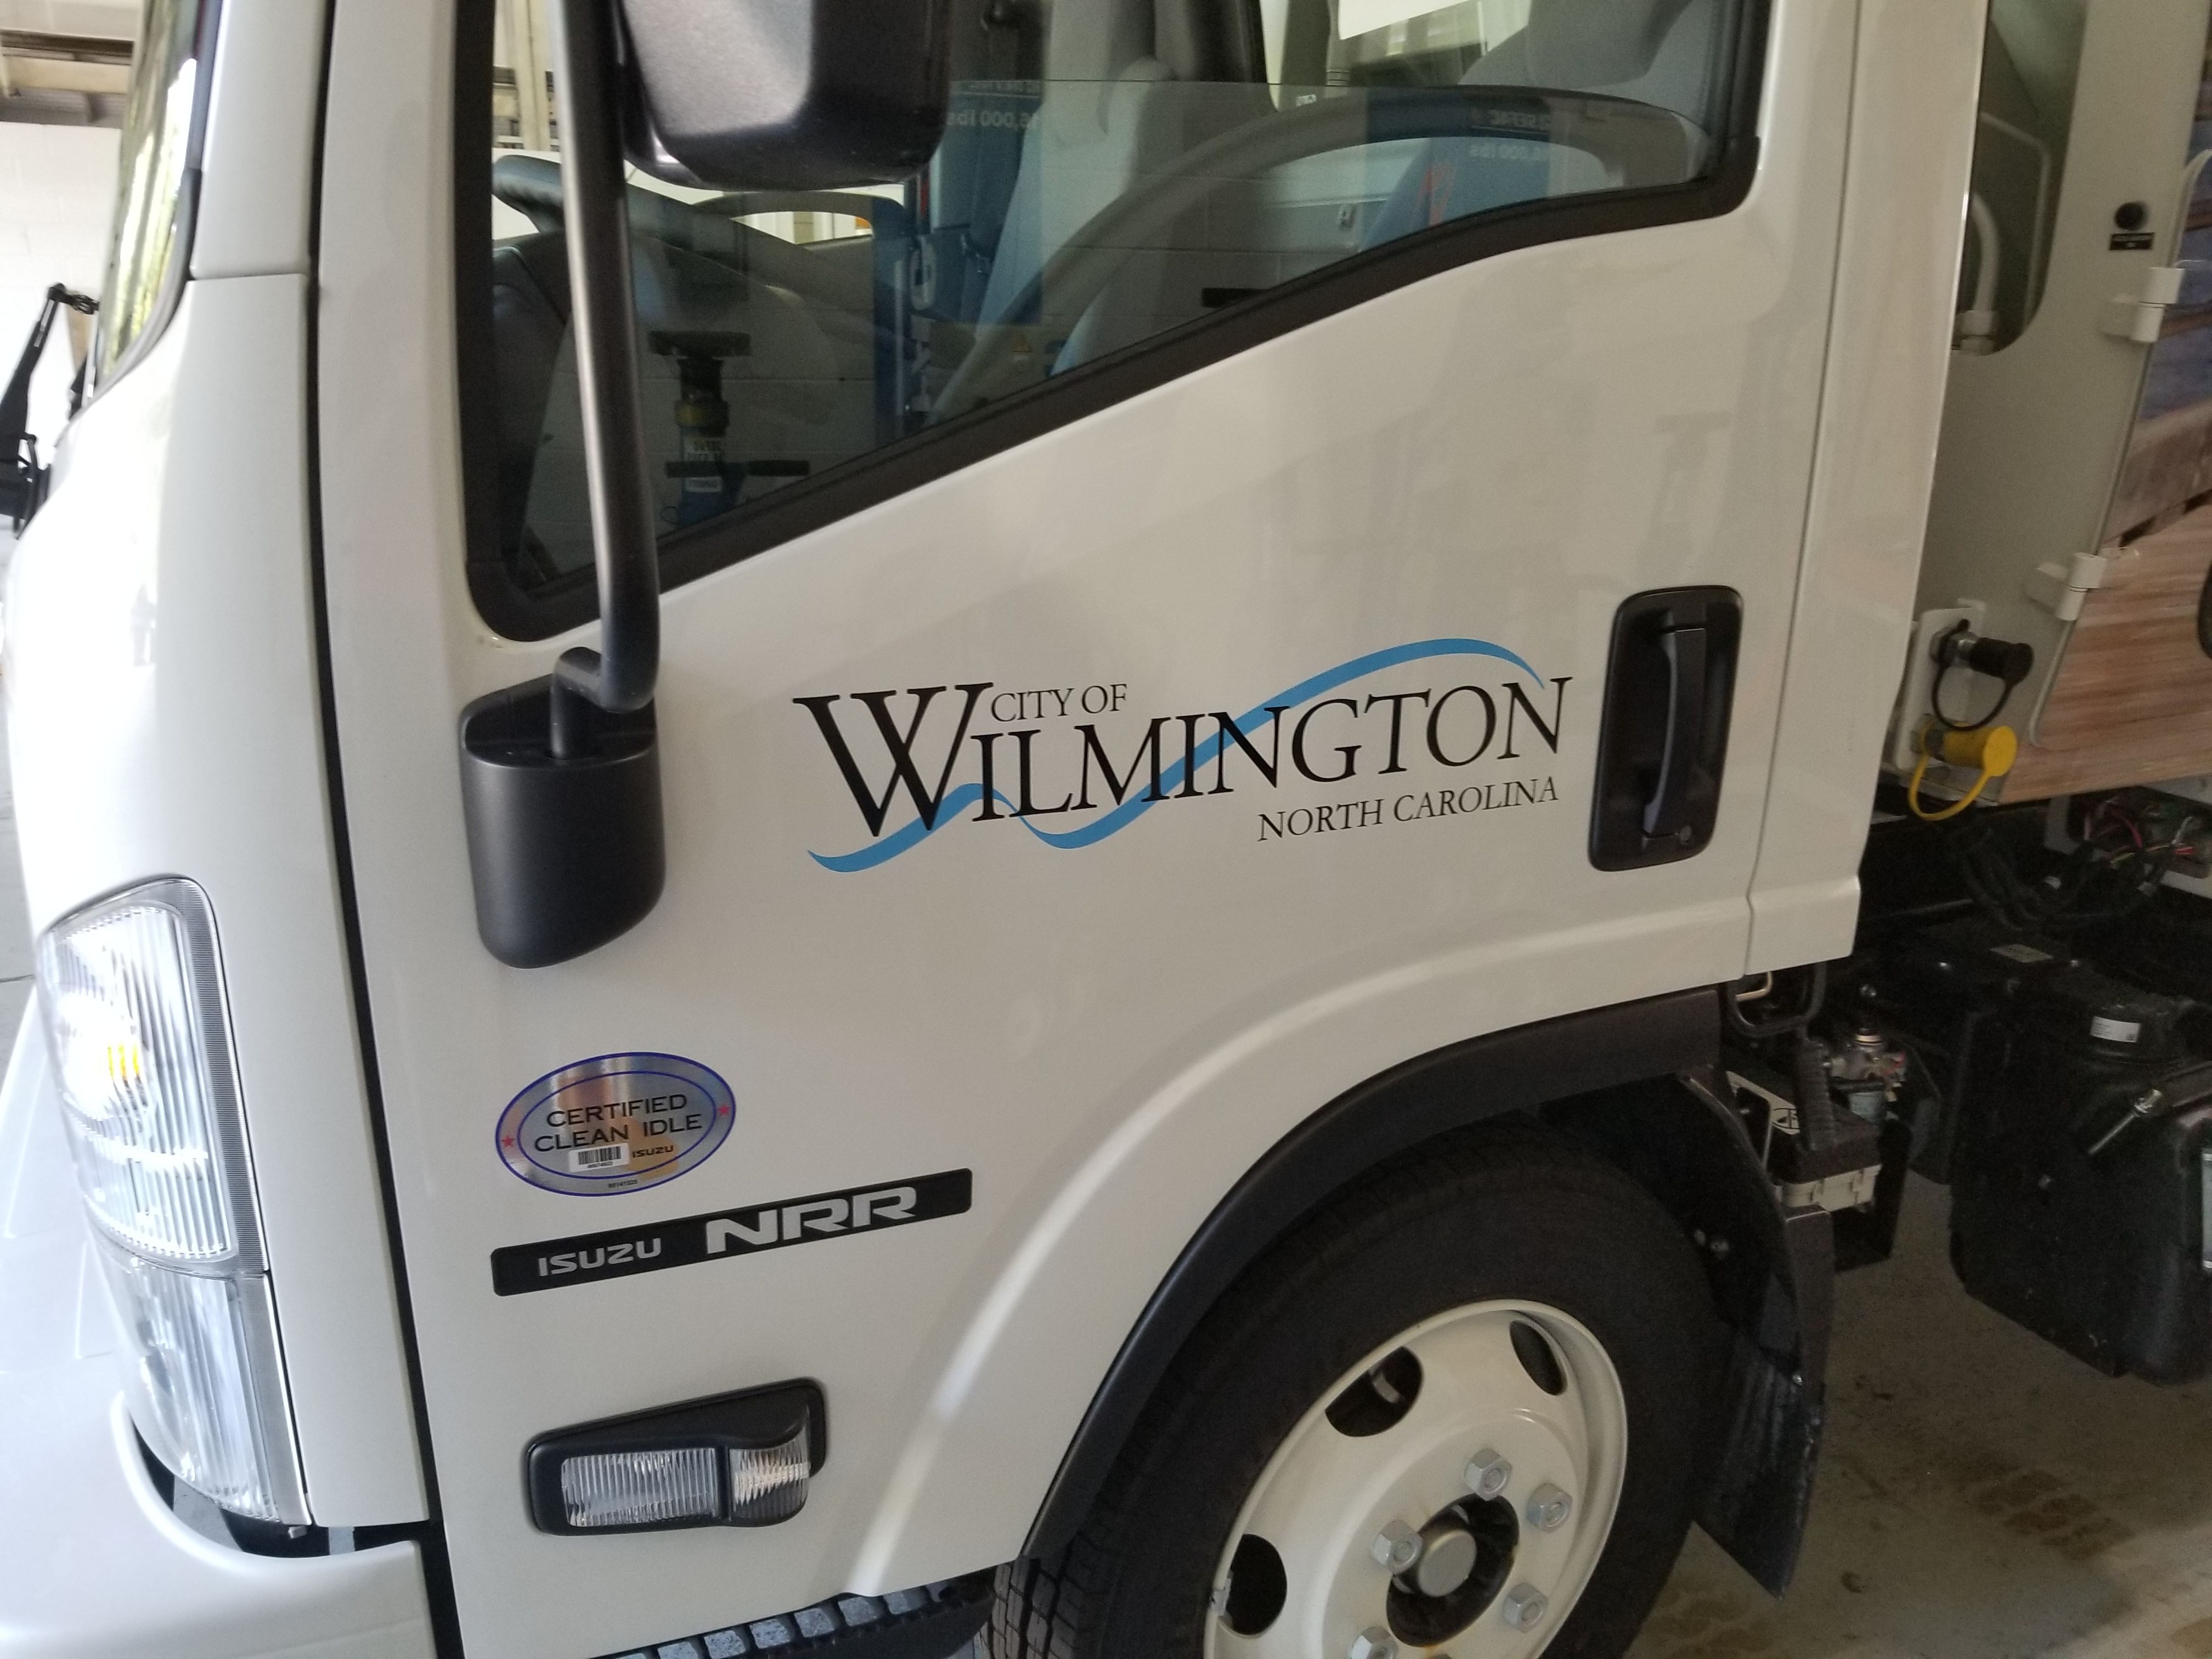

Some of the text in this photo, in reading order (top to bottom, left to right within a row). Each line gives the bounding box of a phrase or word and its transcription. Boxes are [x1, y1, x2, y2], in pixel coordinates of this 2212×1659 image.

[991, 684, 1127, 722] CITY OF
[792, 676, 1573, 837] WILMINGTON
[1257, 776, 1559, 842] NORTH CAROLINA
[546, 1093, 687, 1127] CERTIFIED
[534, 1113, 702, 1152] CLEAN IDLE
[632, 1144, 674, 1158] ISUZU
[538, 1186, 917, 1277] ISUZU NRR
